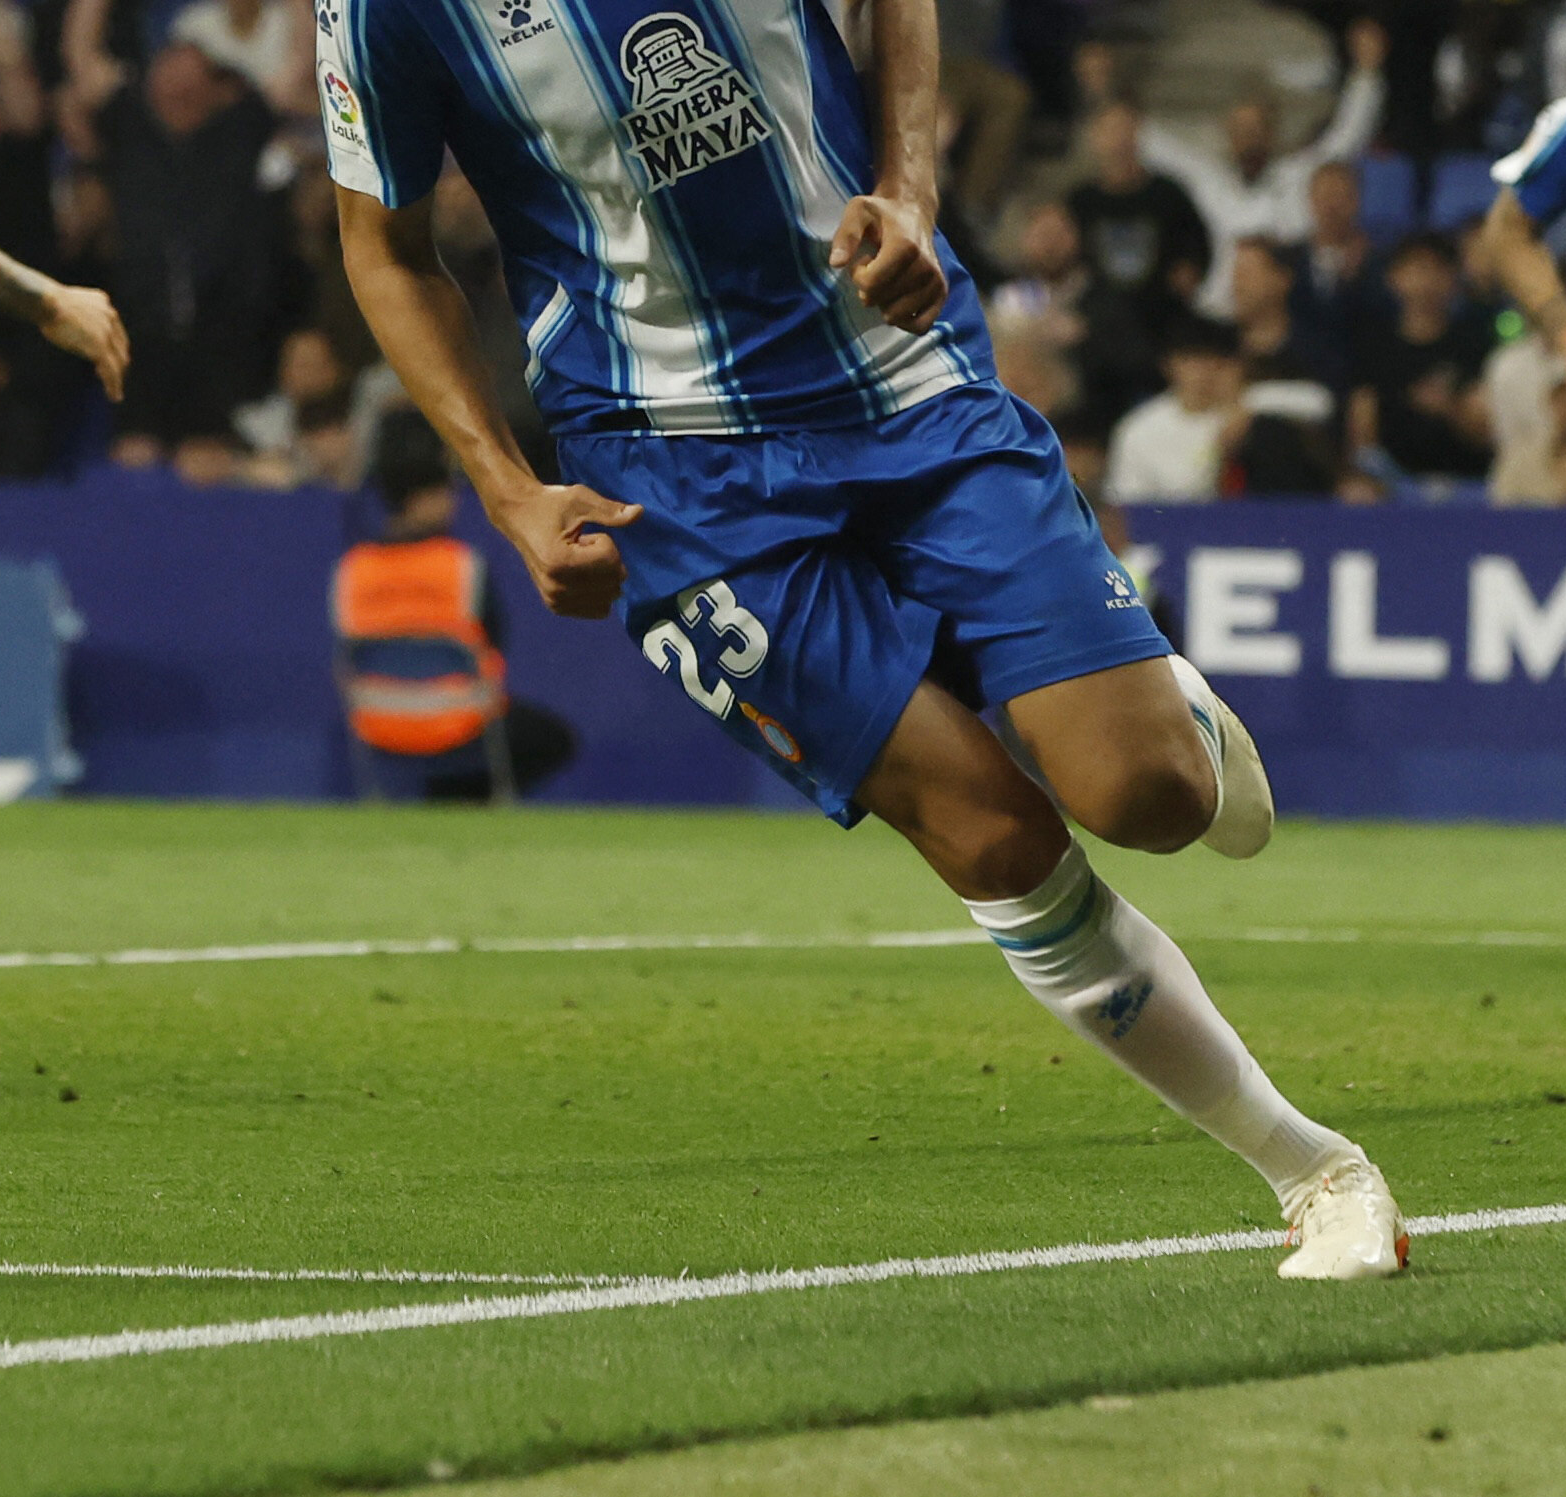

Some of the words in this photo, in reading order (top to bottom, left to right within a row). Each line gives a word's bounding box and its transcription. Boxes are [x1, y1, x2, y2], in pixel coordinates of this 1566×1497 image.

[499, 17, 555, 48] KELME
[628, 75, 749, 146] RIVIERA
[638, 105, 768, 187] MAYA
[641, 579, 769, 721] 23
